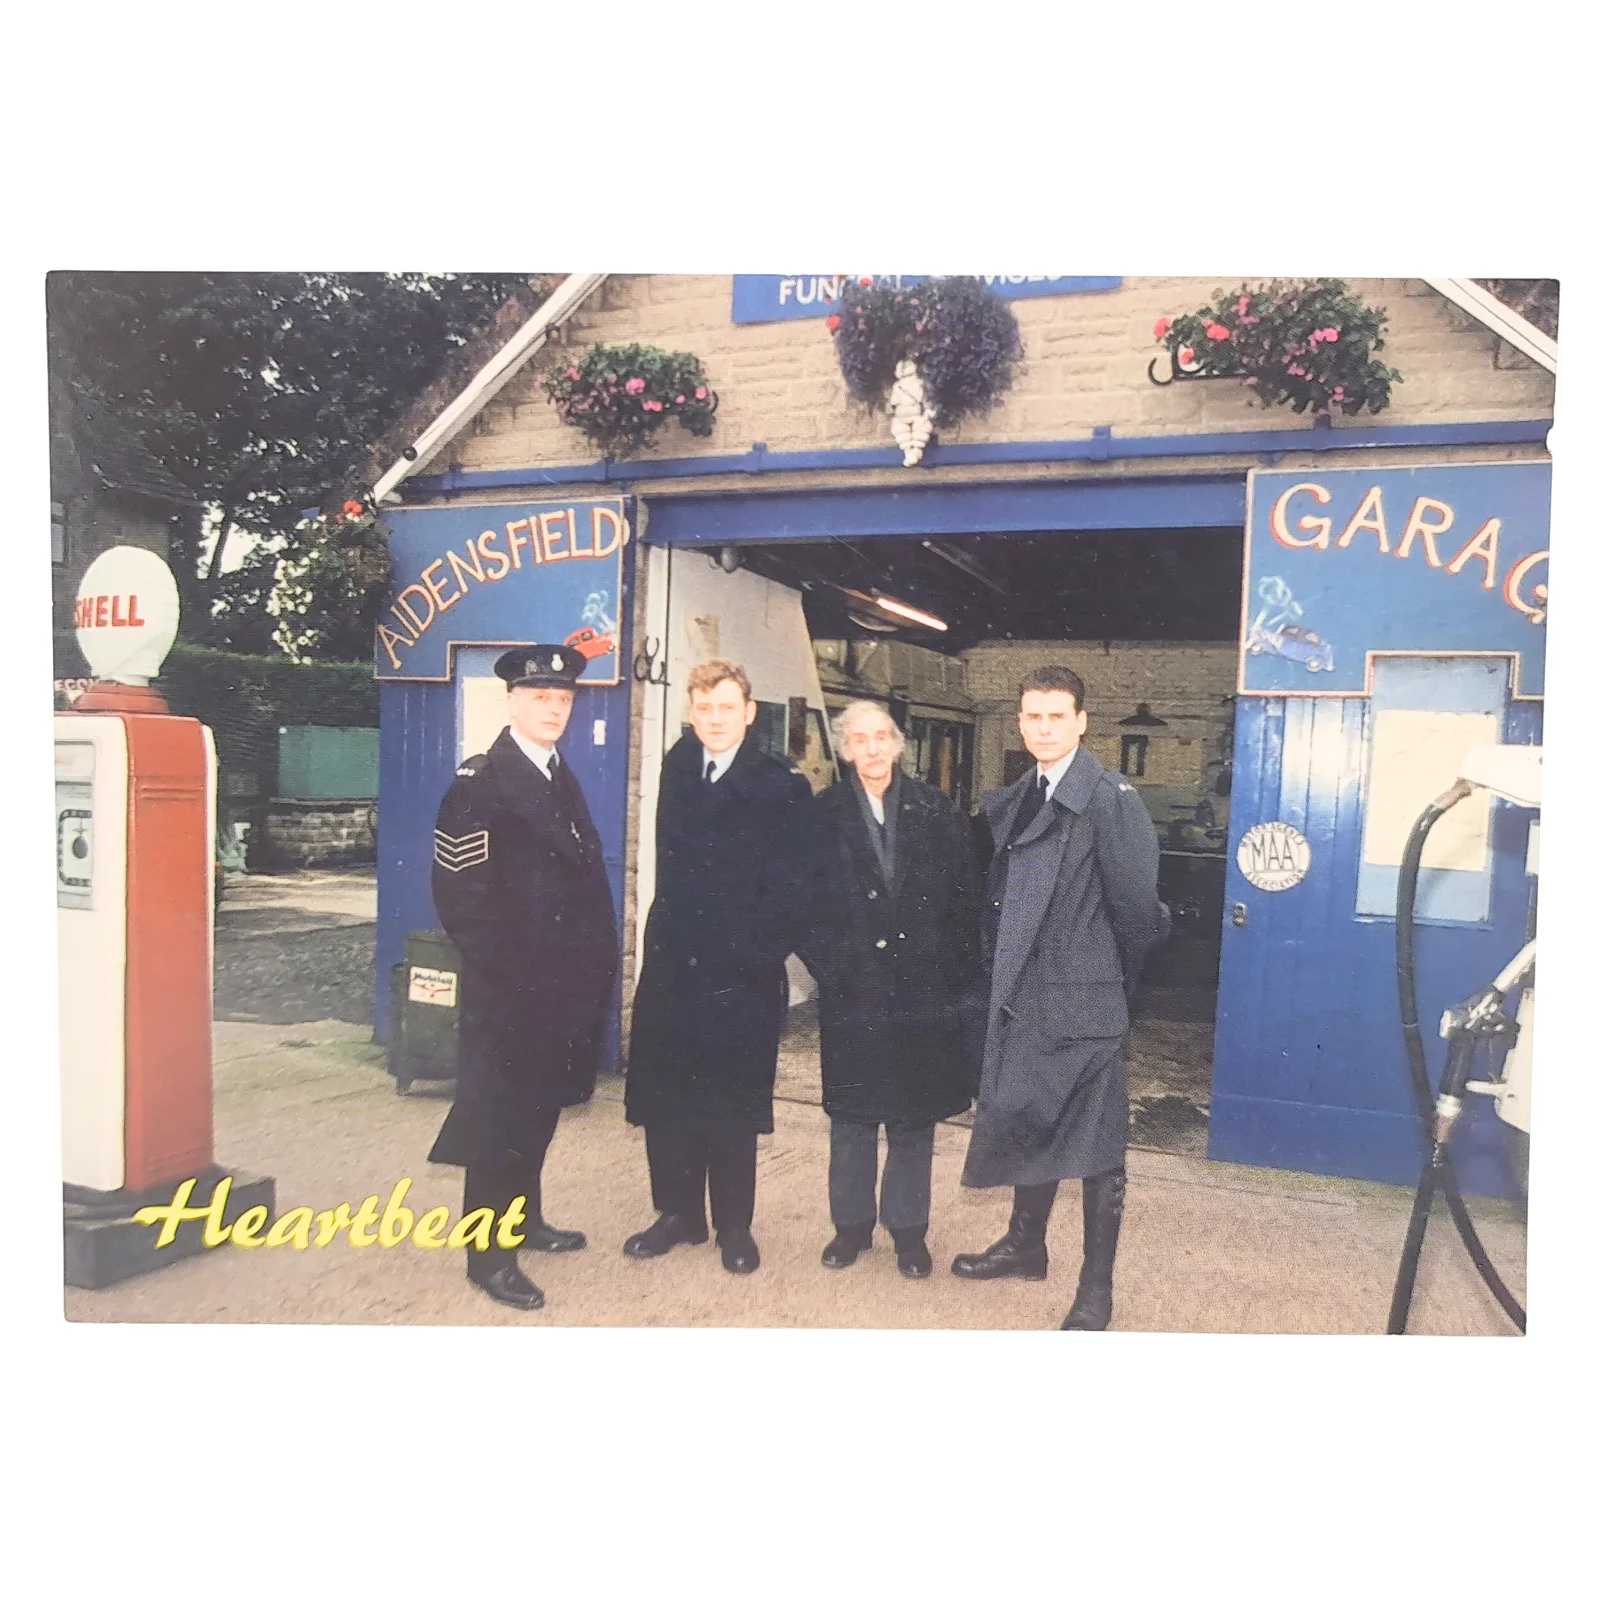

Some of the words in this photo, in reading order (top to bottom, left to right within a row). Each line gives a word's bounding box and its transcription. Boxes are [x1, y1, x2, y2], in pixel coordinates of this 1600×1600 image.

[377, 507, 630, 669] AIDENSFIELD
[75, 595, 145, 628] SHELL
[1252, 831, 1295, 873] MAA
